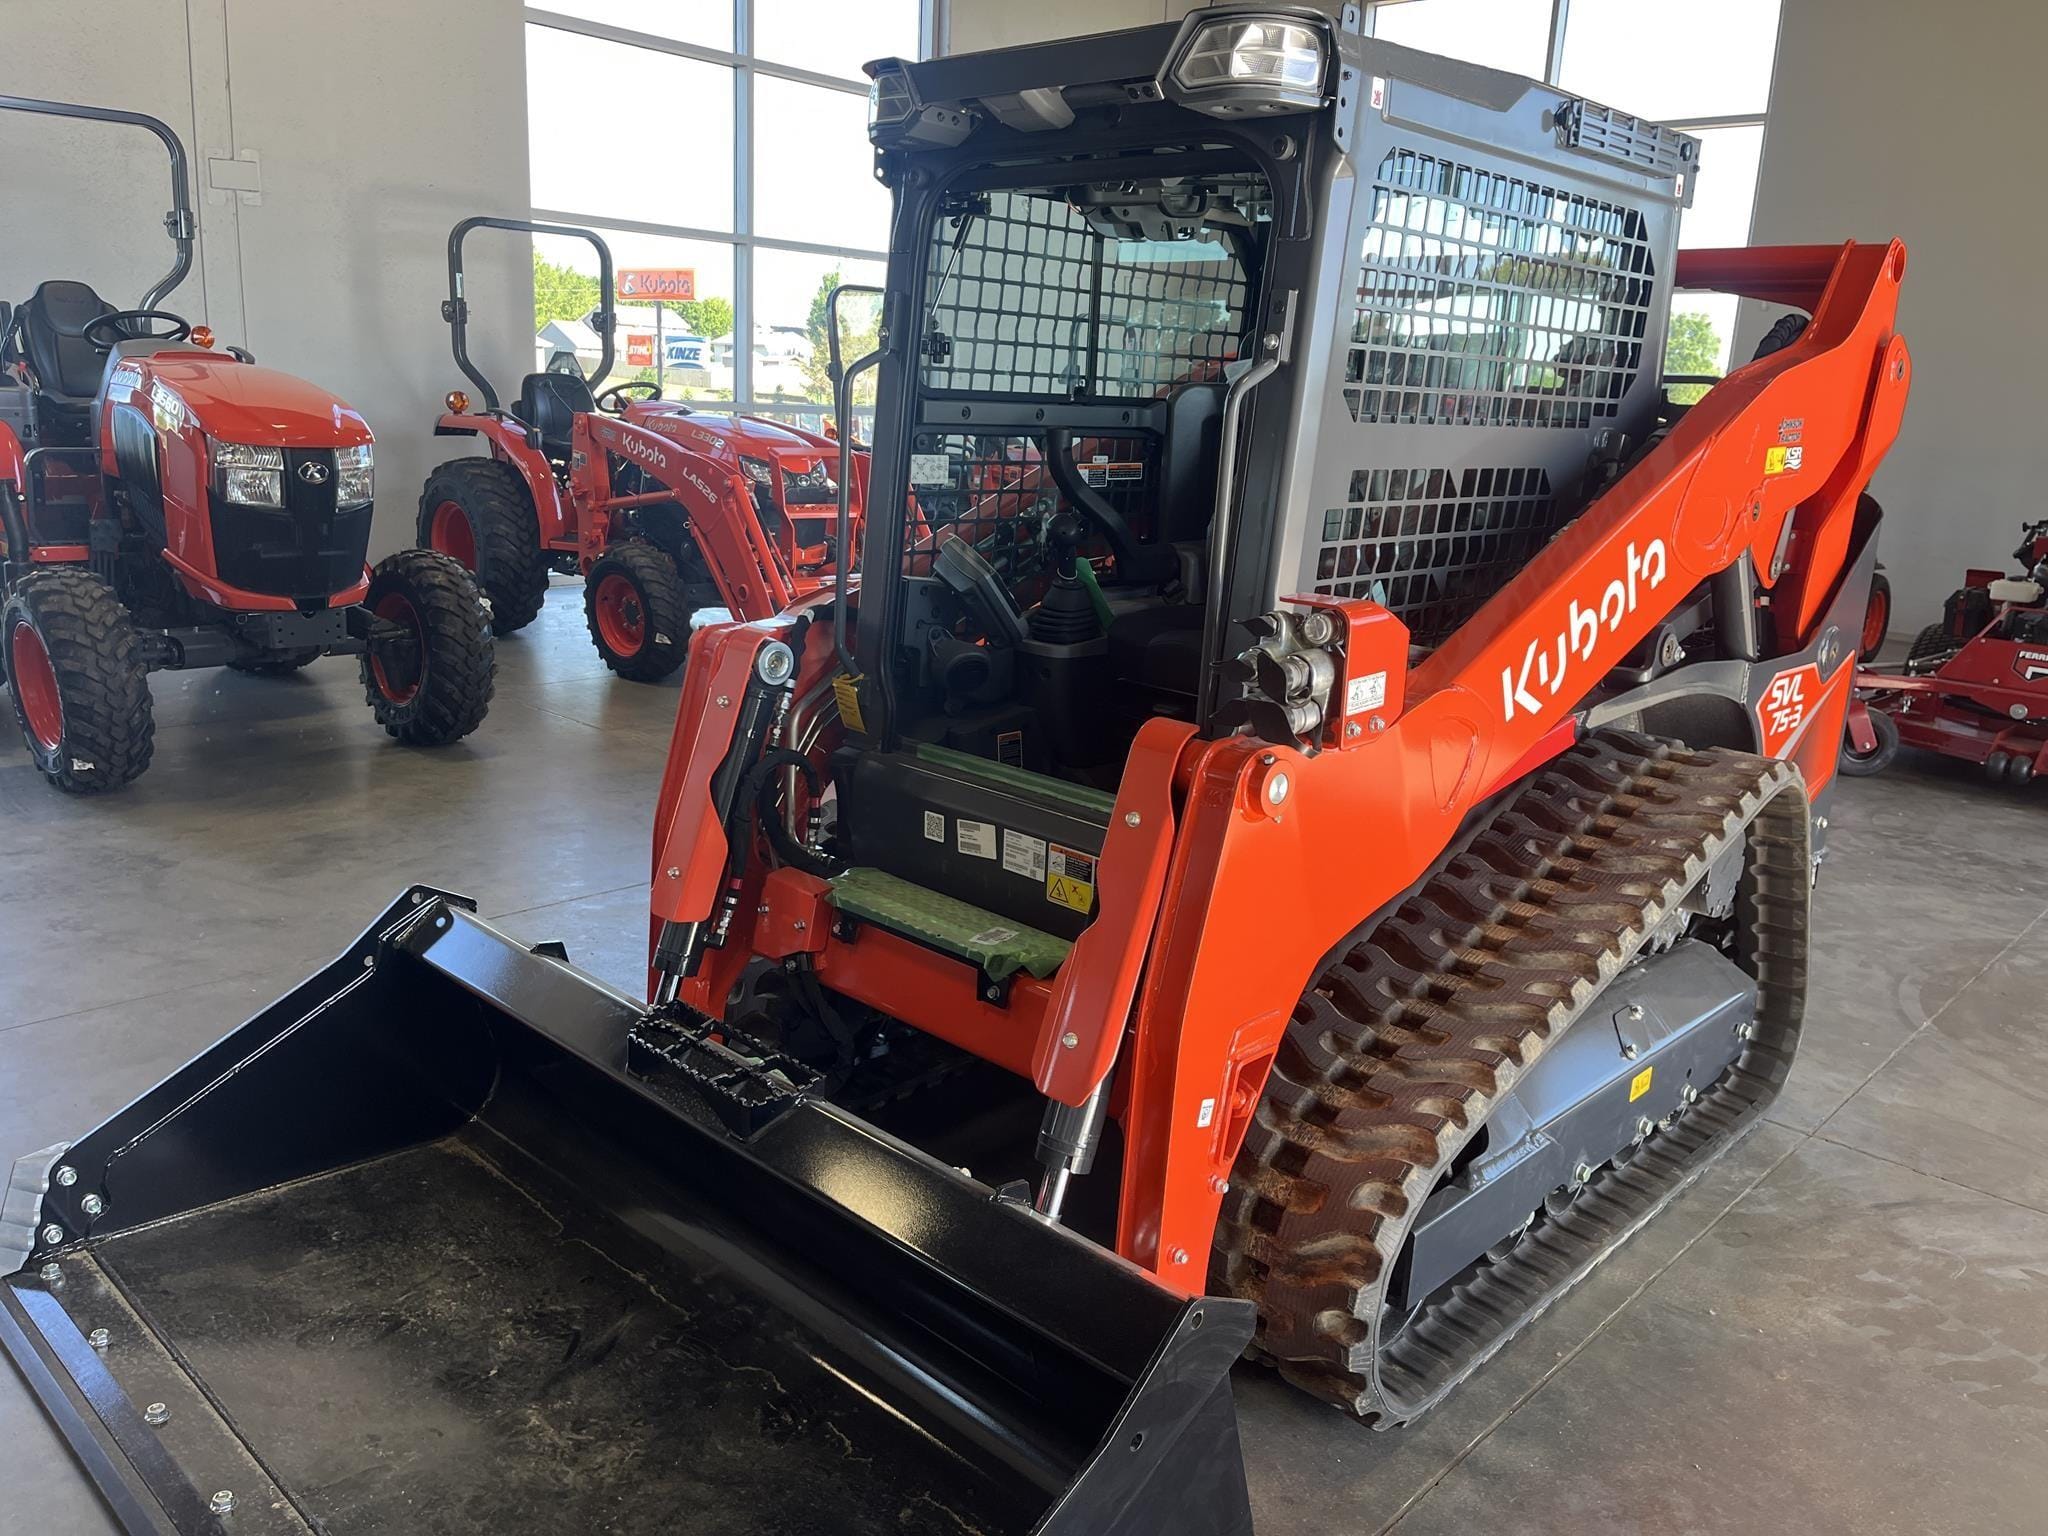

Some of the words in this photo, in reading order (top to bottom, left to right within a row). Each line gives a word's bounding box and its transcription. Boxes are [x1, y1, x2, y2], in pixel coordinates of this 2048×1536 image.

[640, 274, 691, 294] Kubota
[666, 346, 701, 361] KINZE
[644, 419, 678, 433] Kubota
[691, 429, 725, 449] L3302
[622, 432, 666, 469] Kubota
[682, 467, 718, 504] LA526
[1502, 538, 1666, 723] Kubota
[1767, 674, 1804, 711] SVL
